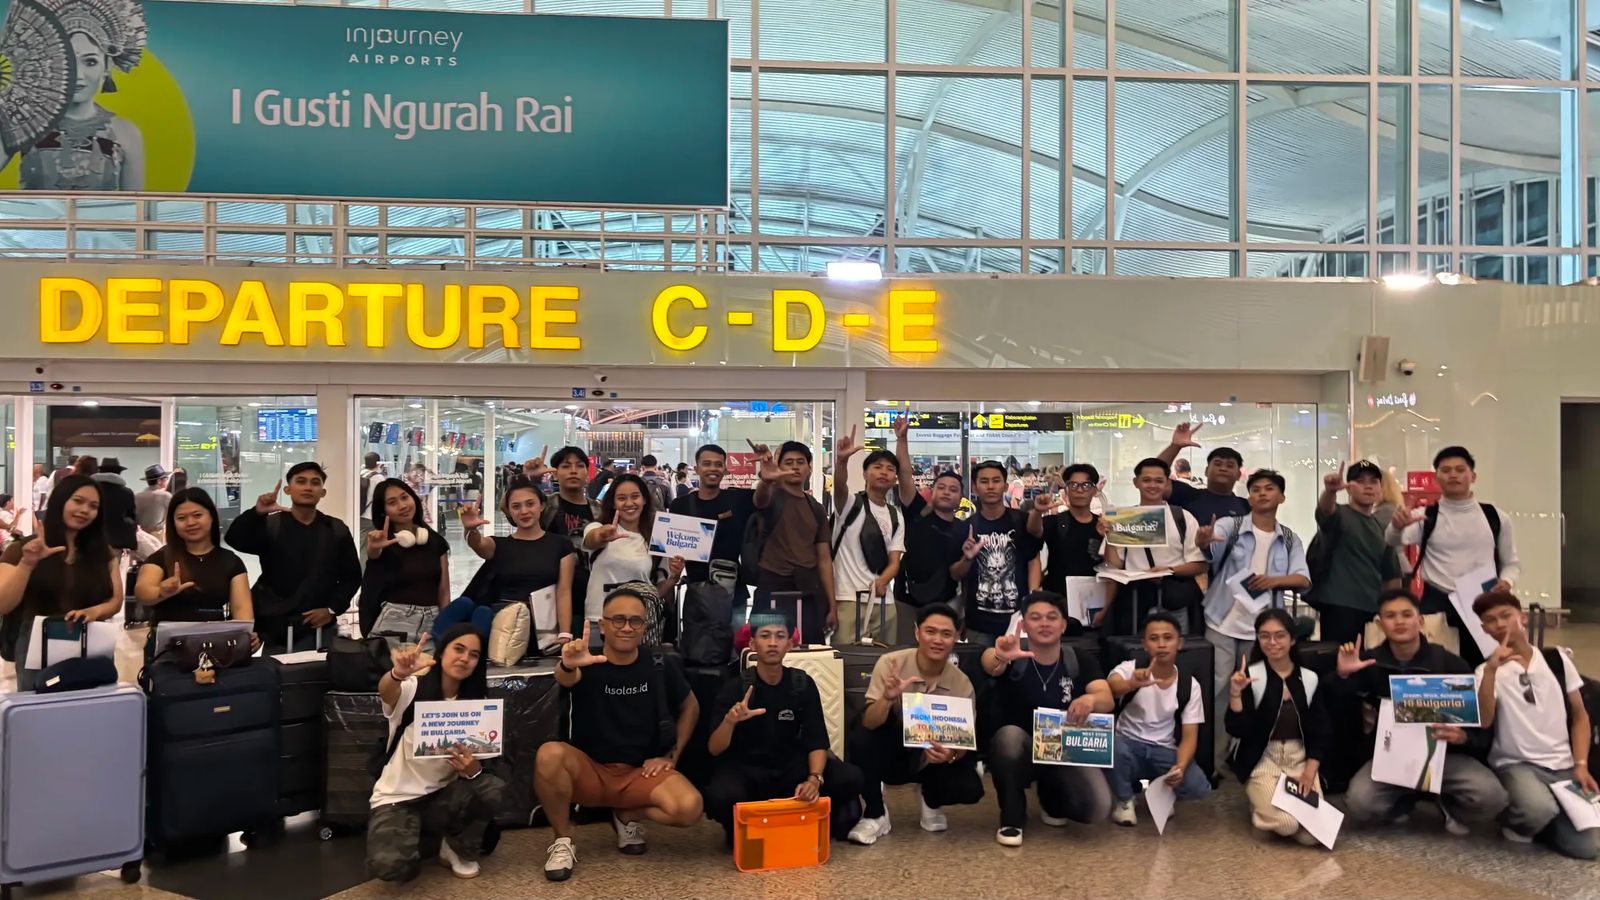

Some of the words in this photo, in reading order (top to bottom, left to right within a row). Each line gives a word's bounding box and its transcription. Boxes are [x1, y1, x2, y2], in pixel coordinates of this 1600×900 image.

[348, 54, 458, 67] AIRPORTS
[231, 88, 241, 125] I
[254, 89, 351, 128] Gusti
[363, 91, 503, 141] Ngurah
[515, 96, 573, 134] Rai
[39, 277, 582, 350] DEPARTURE
[666, 530, 701, 544] Welcome
[666, 538, 698, 549] Bulgaria
[421, 711, 441, 719] LET'S
[441, 711, 459, 719] JOIN
[910, 713, 931, 721] FROM
[931, 715, 968, 724] INDONESIA
[1065, 735, 1108, 749] BULGARIA
